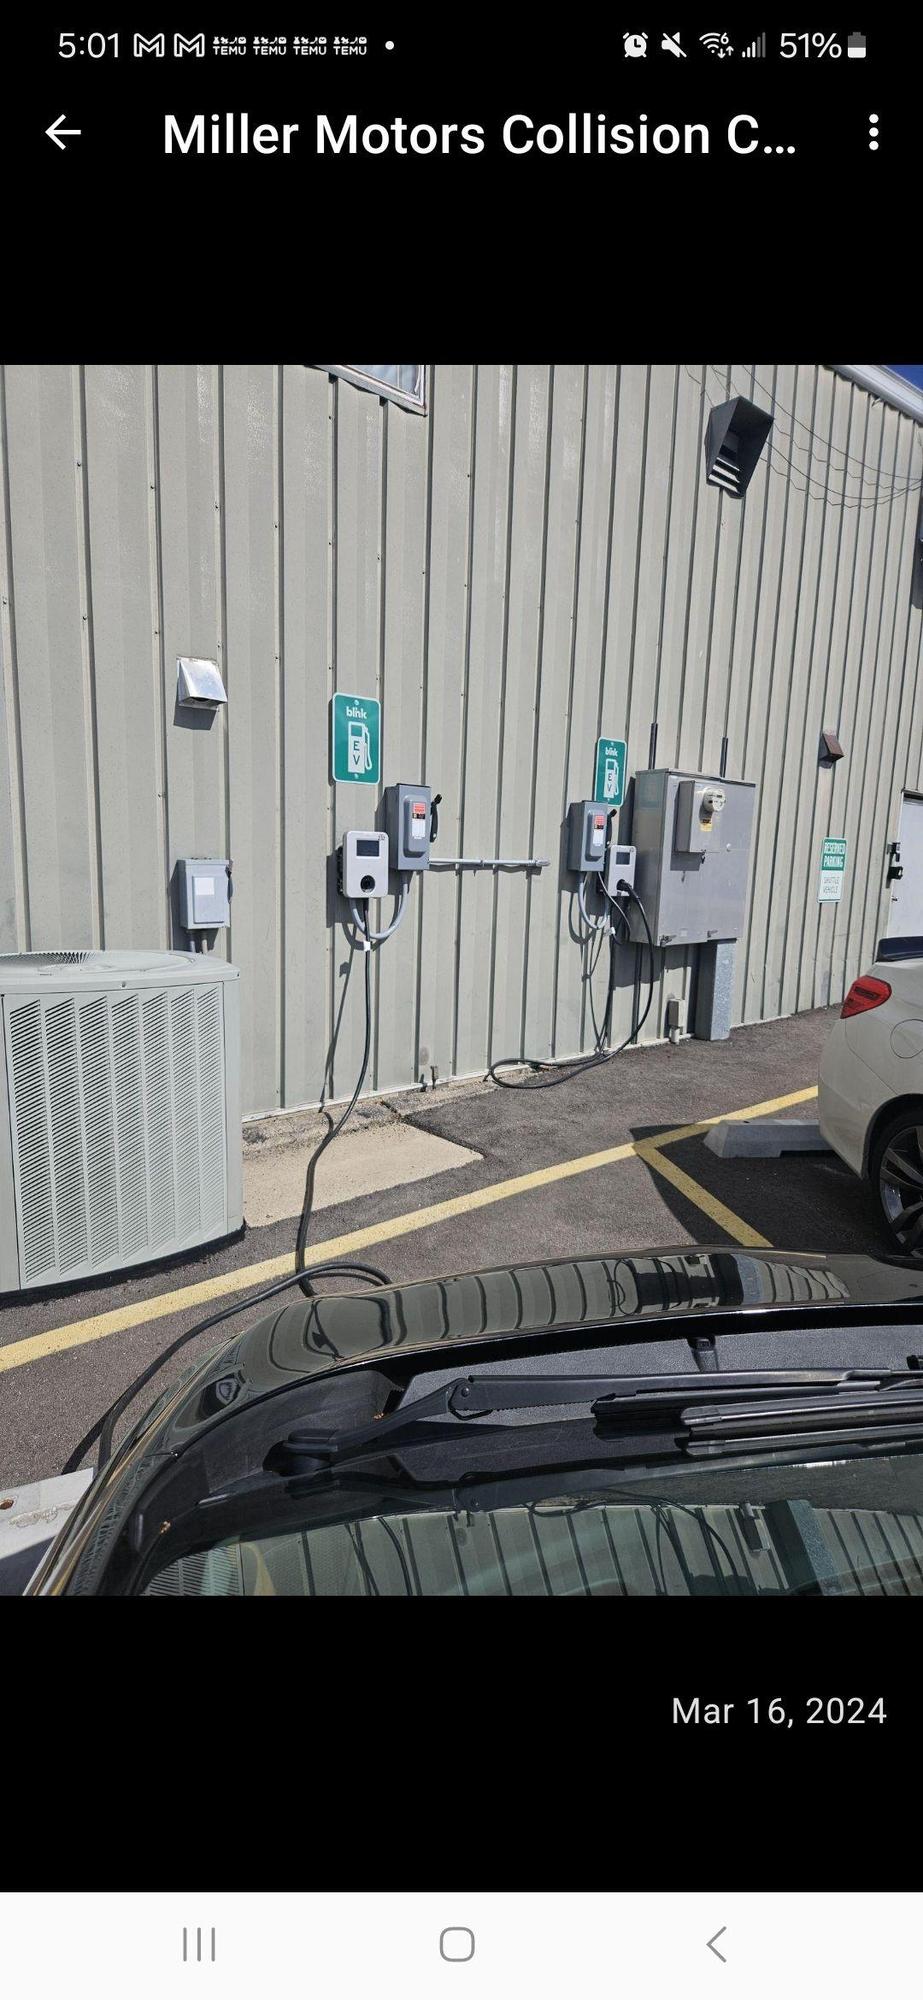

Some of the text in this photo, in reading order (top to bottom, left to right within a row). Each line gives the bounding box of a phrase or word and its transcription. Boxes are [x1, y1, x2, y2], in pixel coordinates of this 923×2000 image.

[346, 706, 367, 719] blink
[824, 842, 846, 854] RESERVED
[823, 855, 844, 867] PARKING
